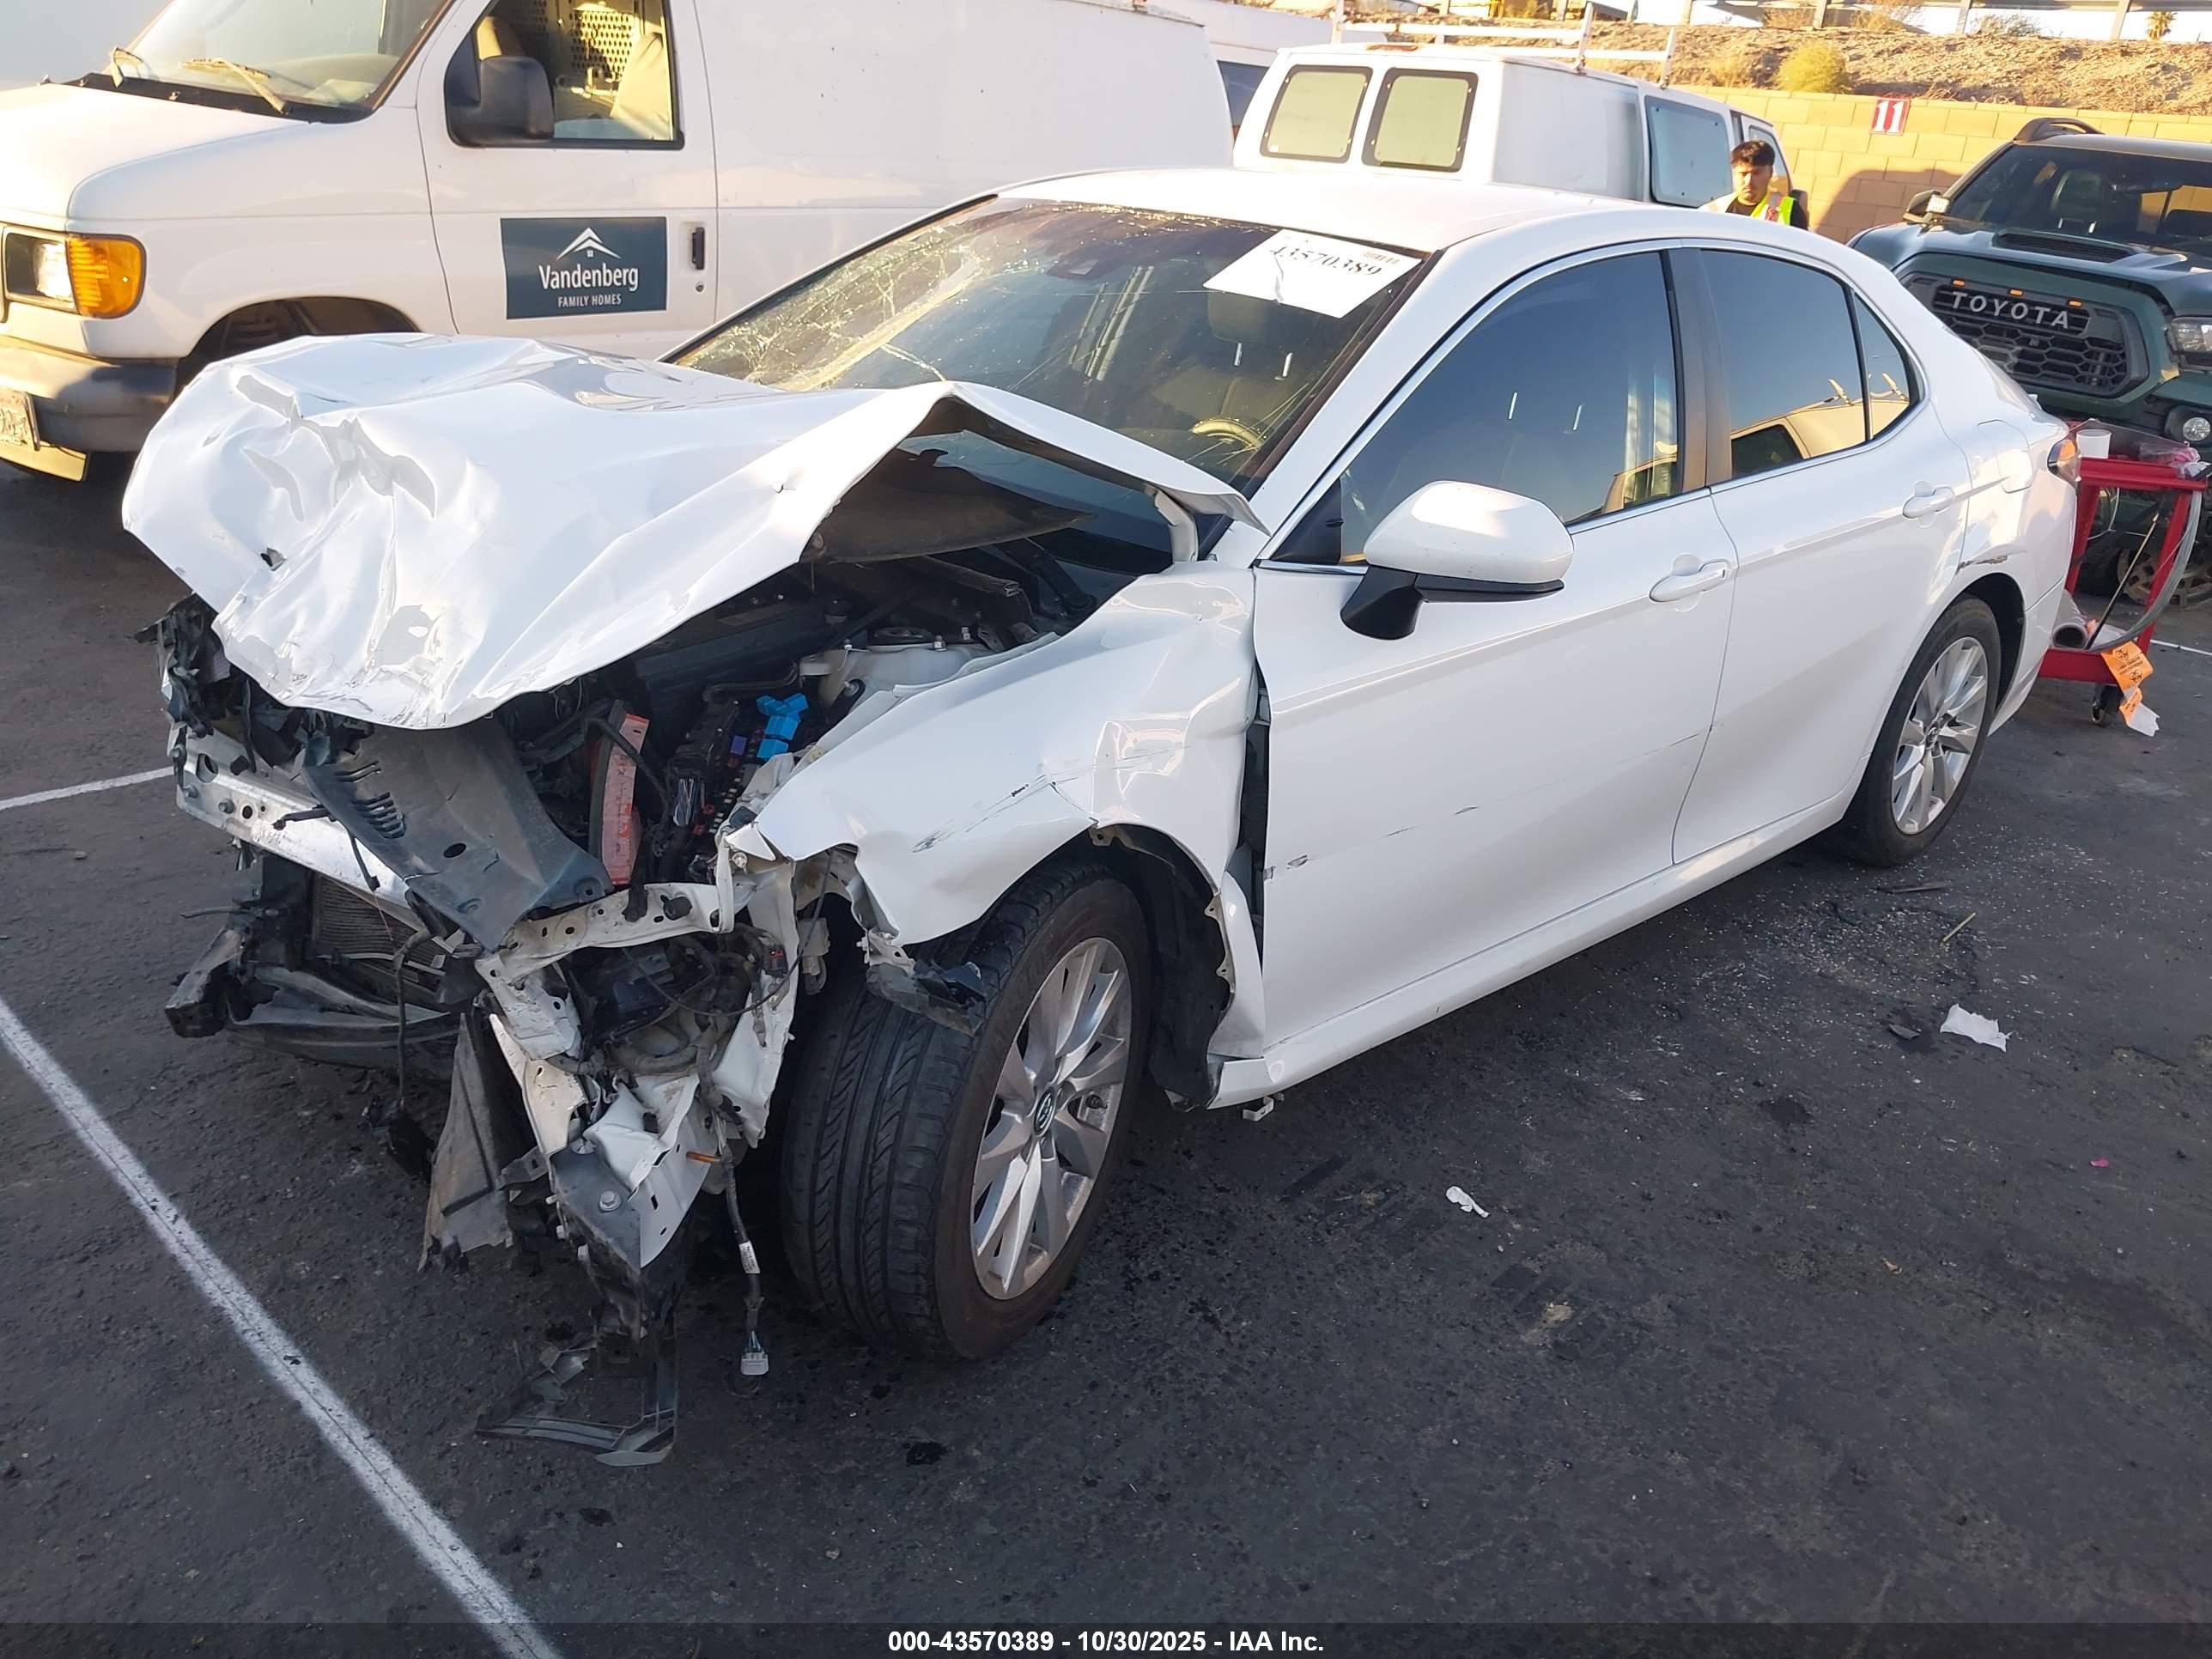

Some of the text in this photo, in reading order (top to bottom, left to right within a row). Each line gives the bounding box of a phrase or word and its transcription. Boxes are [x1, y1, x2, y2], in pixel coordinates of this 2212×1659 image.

[1873, 100, 1905, 133] 11
[538, 263, 639, 291] Vandenberg
[558, 294, 622, 307] FAMILY HOMES
[1952, 291, 2069, 329] TOYOTA
